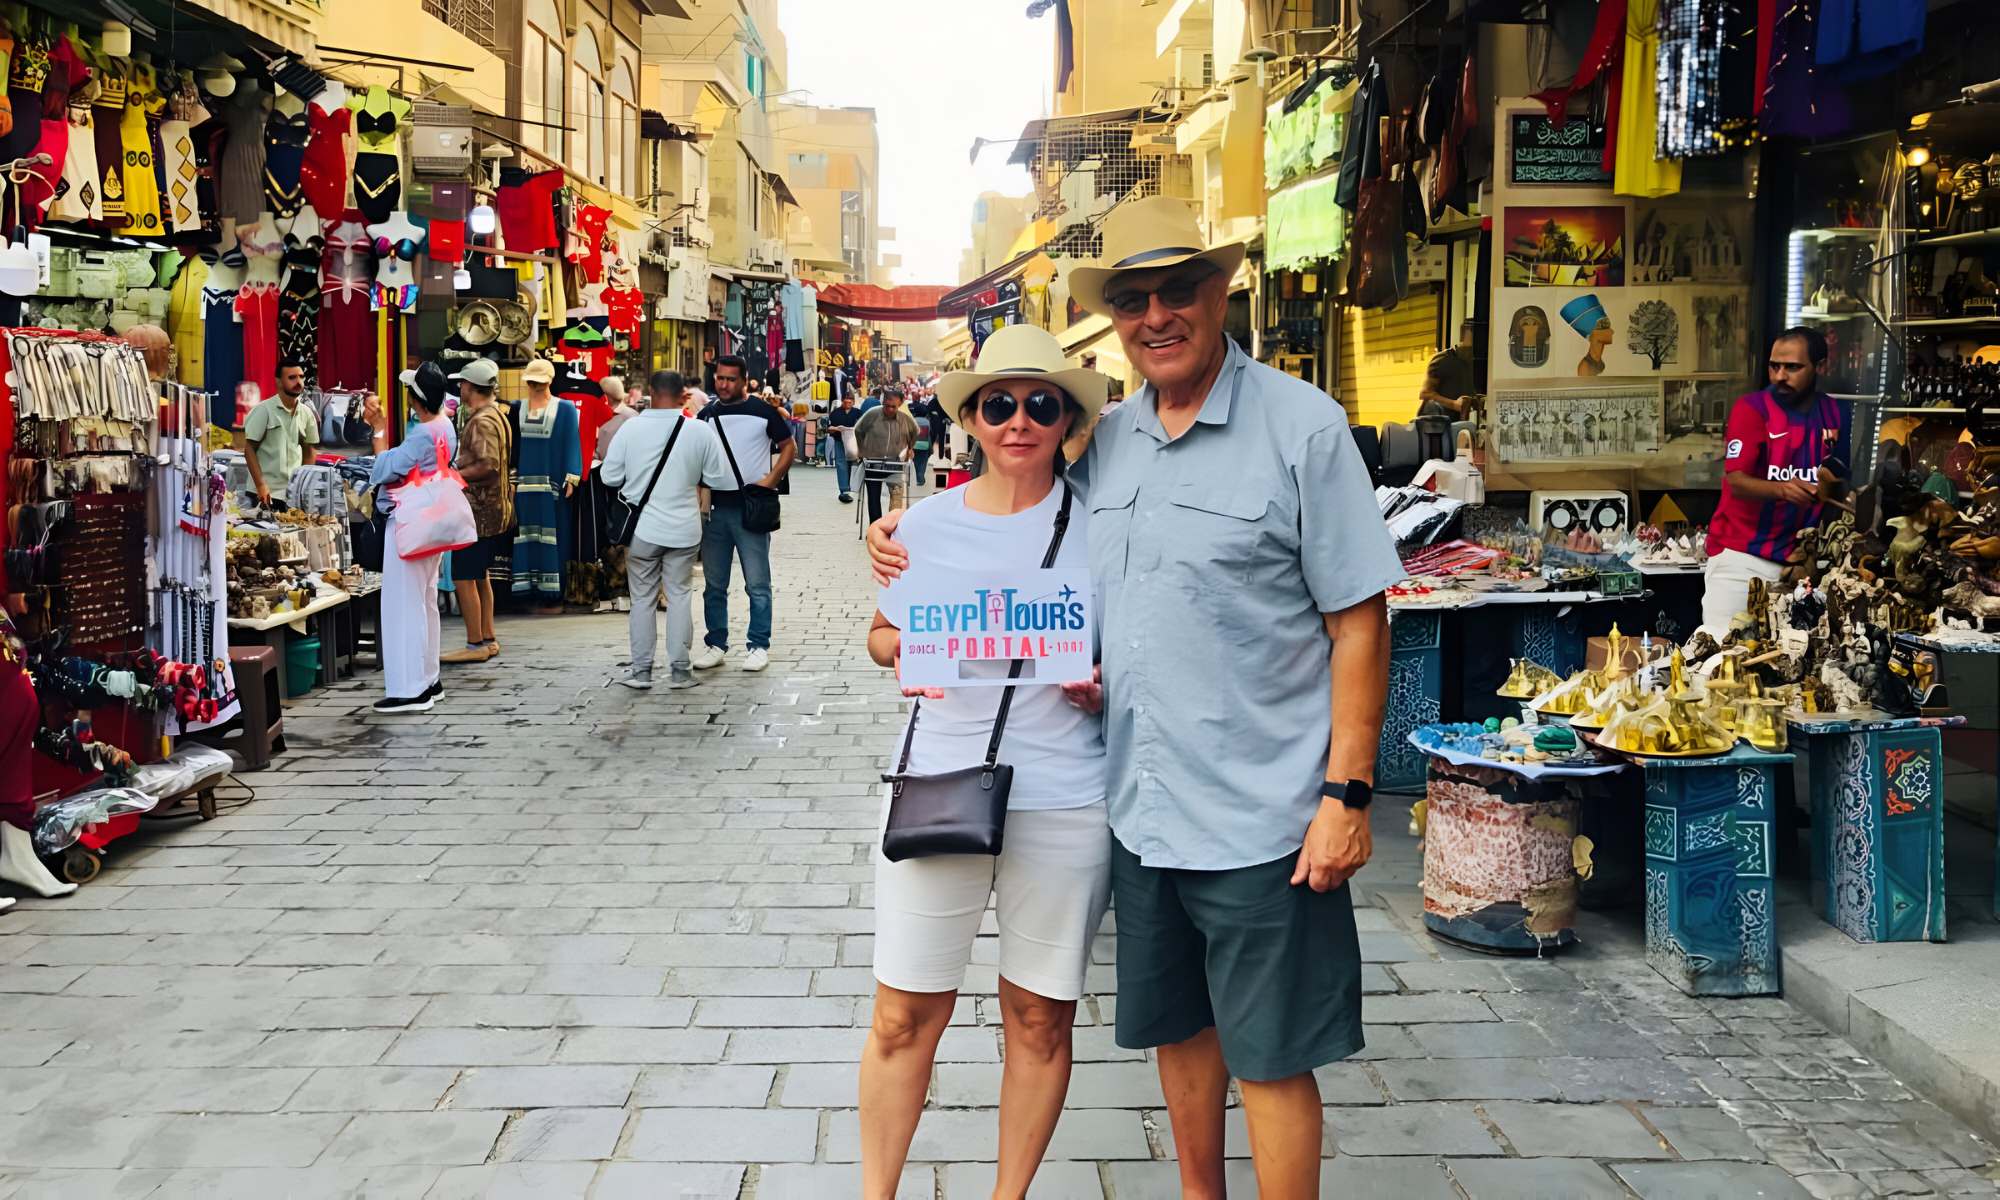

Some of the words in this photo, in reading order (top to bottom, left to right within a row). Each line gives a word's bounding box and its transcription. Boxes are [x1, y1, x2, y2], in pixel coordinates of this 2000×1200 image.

[909, 589, 990, 633] EGYPT
[1001, 588, 1085, 632] TOURS
[947, 636, 1049, 659] PORTAL
